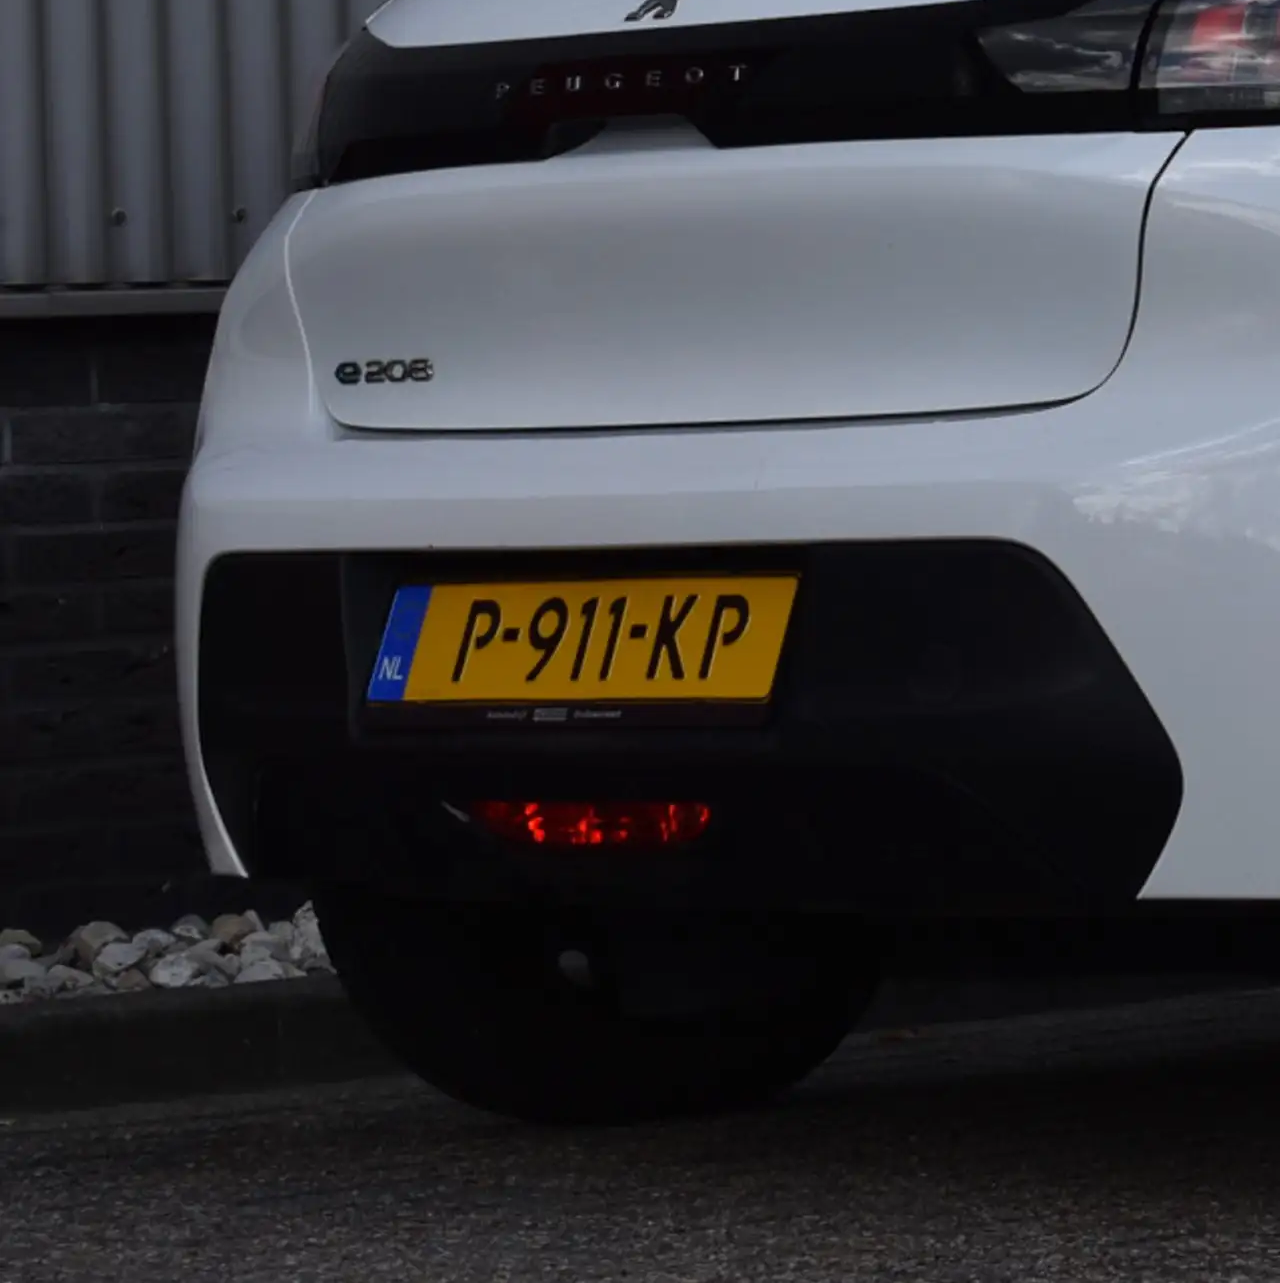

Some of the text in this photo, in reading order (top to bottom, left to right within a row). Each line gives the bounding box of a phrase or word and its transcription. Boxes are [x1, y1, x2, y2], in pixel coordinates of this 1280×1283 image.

[494, 63, 748, 99] PEUGEOT
[451, 594, 752, 683] P-911-KP
[378, 655, 404, 681] NL
